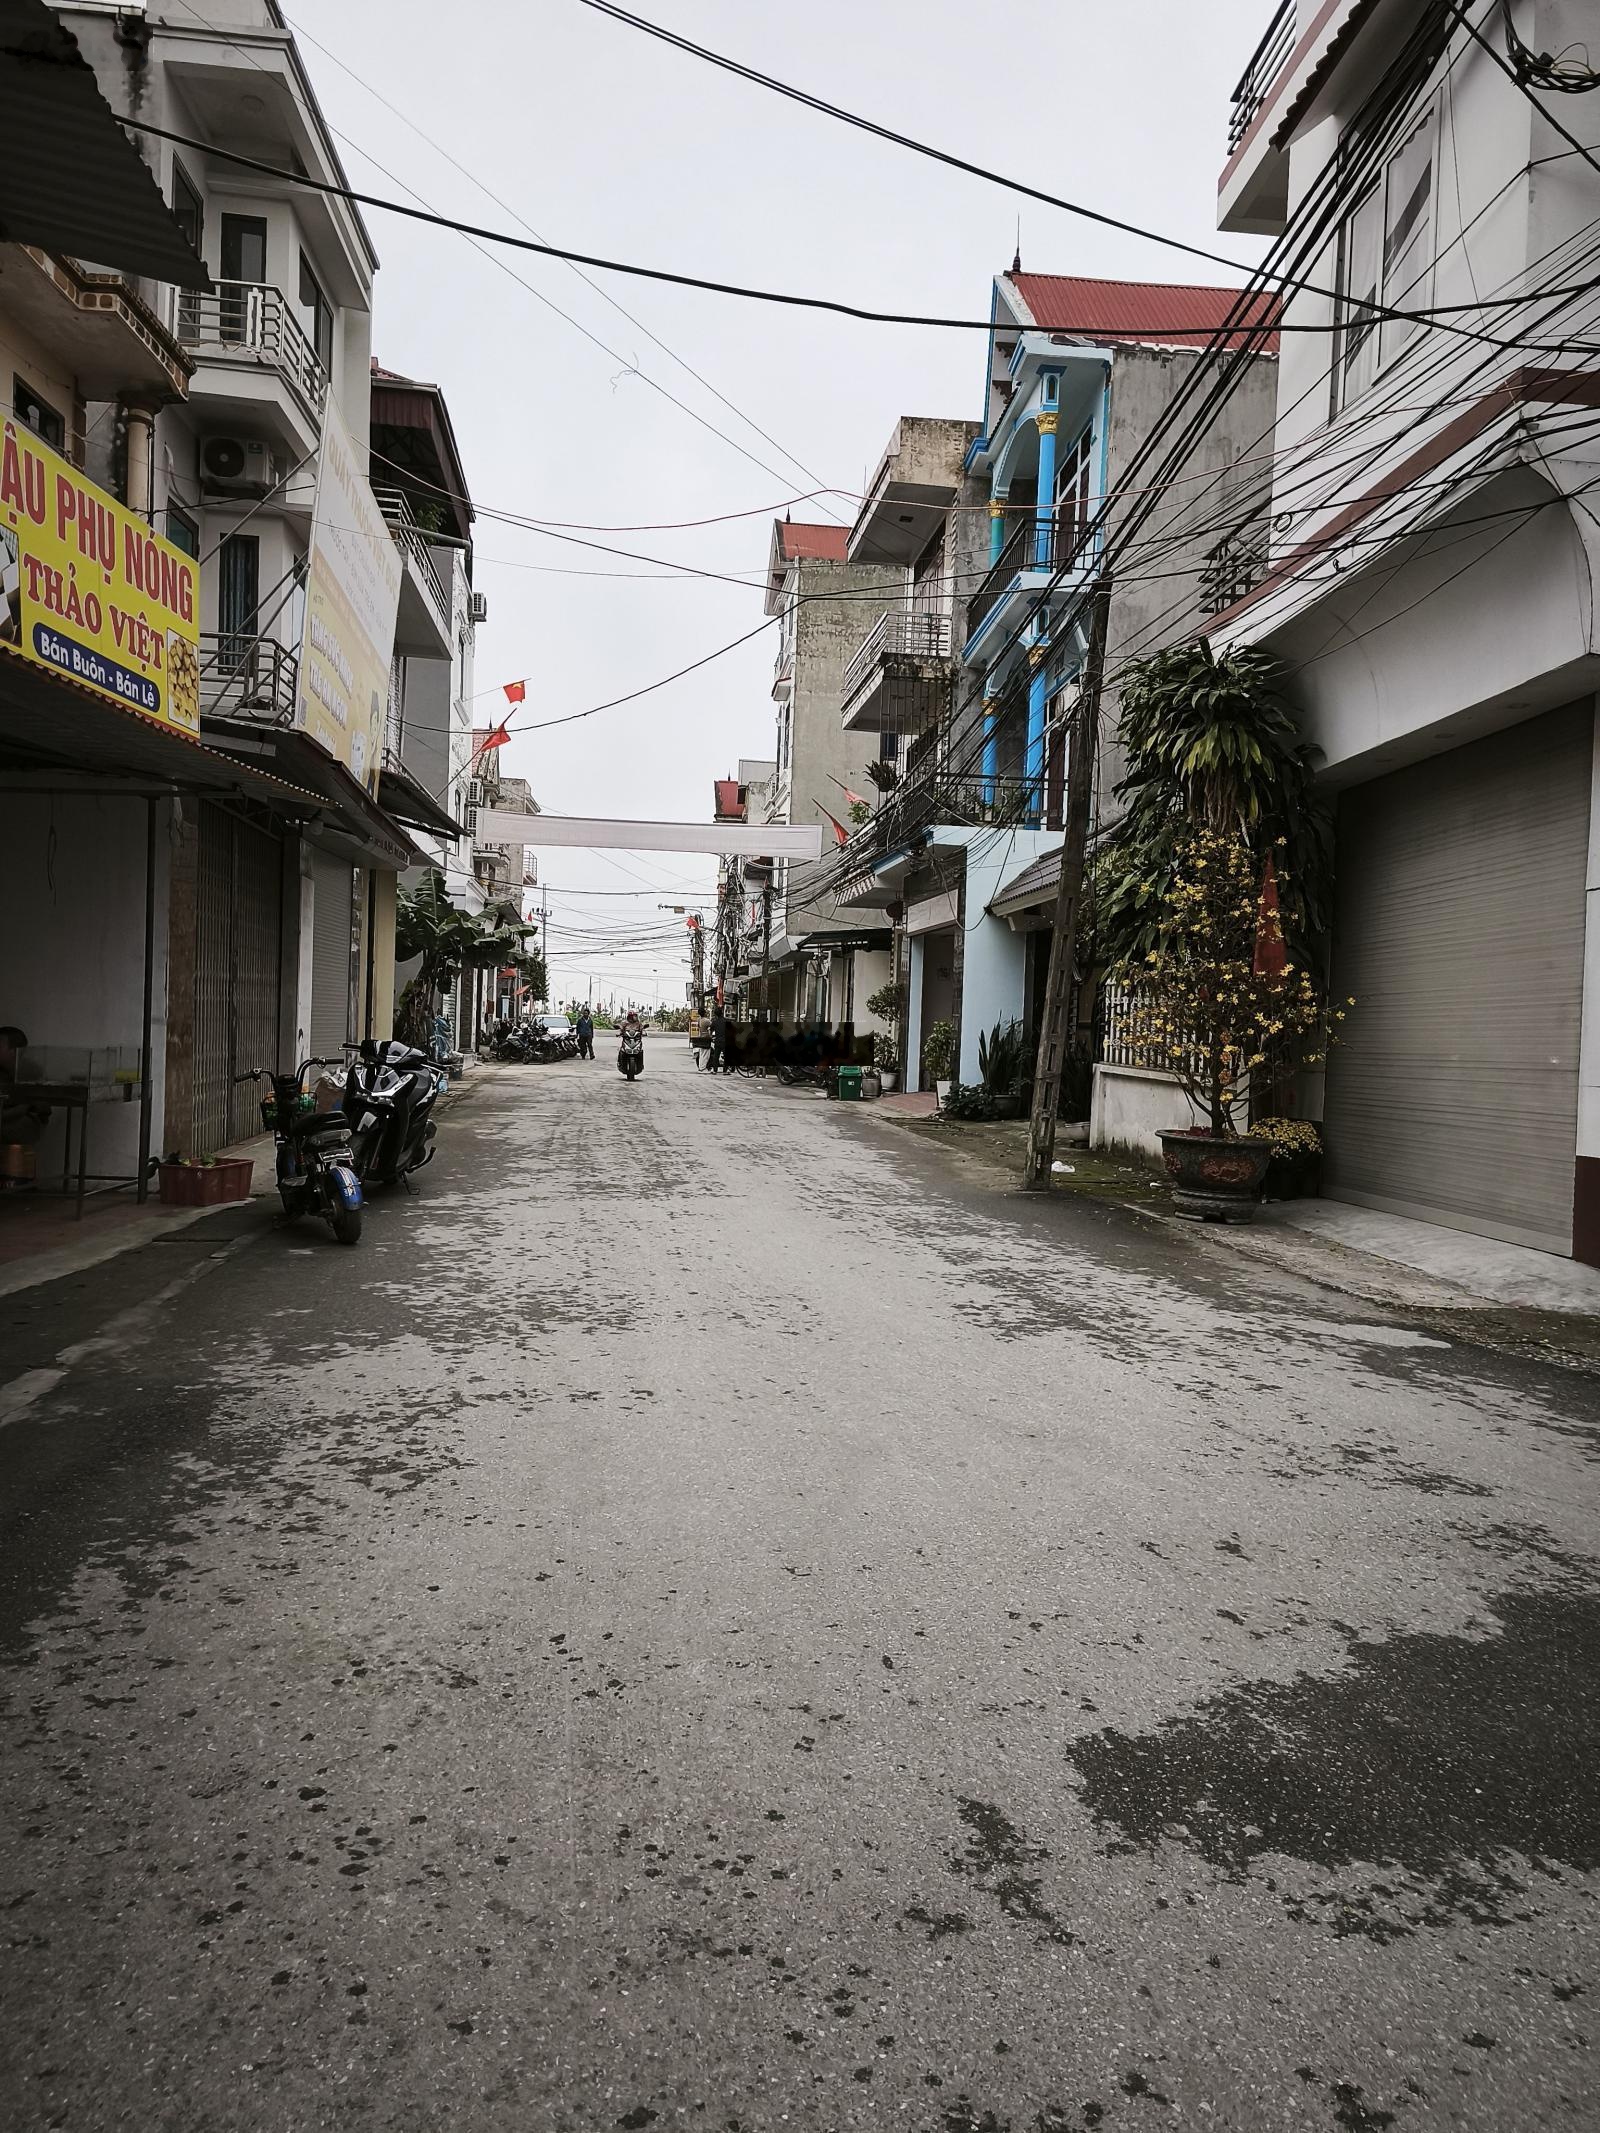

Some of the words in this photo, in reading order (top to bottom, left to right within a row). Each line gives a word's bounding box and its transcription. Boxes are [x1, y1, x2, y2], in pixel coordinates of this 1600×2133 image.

[1, 421, 46, 525] ẬU
[56, 473, 116, 586] PHỤ
[123, 531, 194, 624] NÓNG
[23, 552, 102, 635] THẢO
[109, 605, 164, 673] VIỆT
[40, 631, 70, 668] Bán
[72, 651, 106, 686] Buôn
[115, 672, 140, 701] Bán
